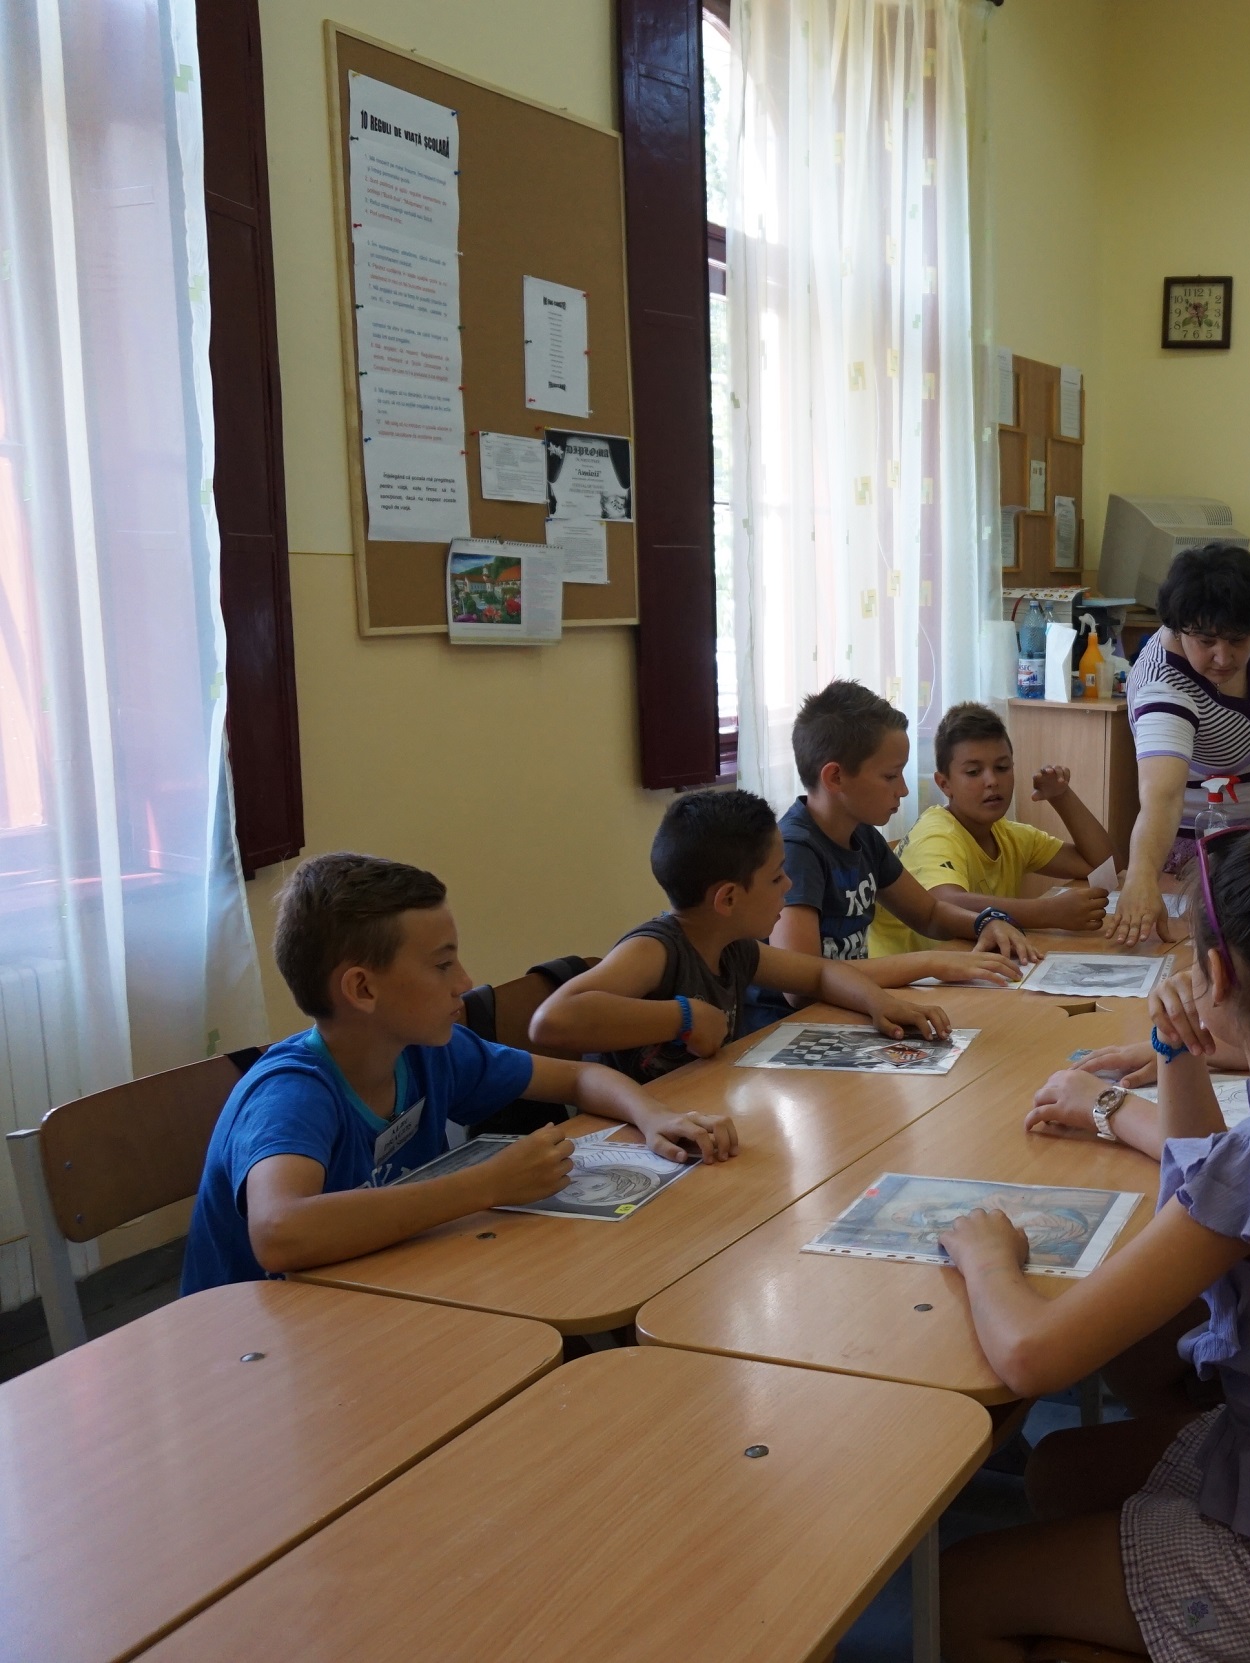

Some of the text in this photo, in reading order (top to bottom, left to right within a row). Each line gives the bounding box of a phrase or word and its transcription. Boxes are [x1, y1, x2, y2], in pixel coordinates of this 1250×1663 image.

[361, 110, 368, 129] 10
[371, 115, 392, 135] REGULI
[394, 126, 402, 138] DE
[1184, 289, 1192, 297] 11
[1194, 288, 1205, 297] 12
[1174, 296, 1184, 304] 10
[1215, 295, 1222, 304] 2
[1175, 308, 1182, 317] 9
[1174, 321, 1182, 330] 8
[1193, 330, 1200, 339] 6
[566, 444, 609, 458] DIPLOMA
